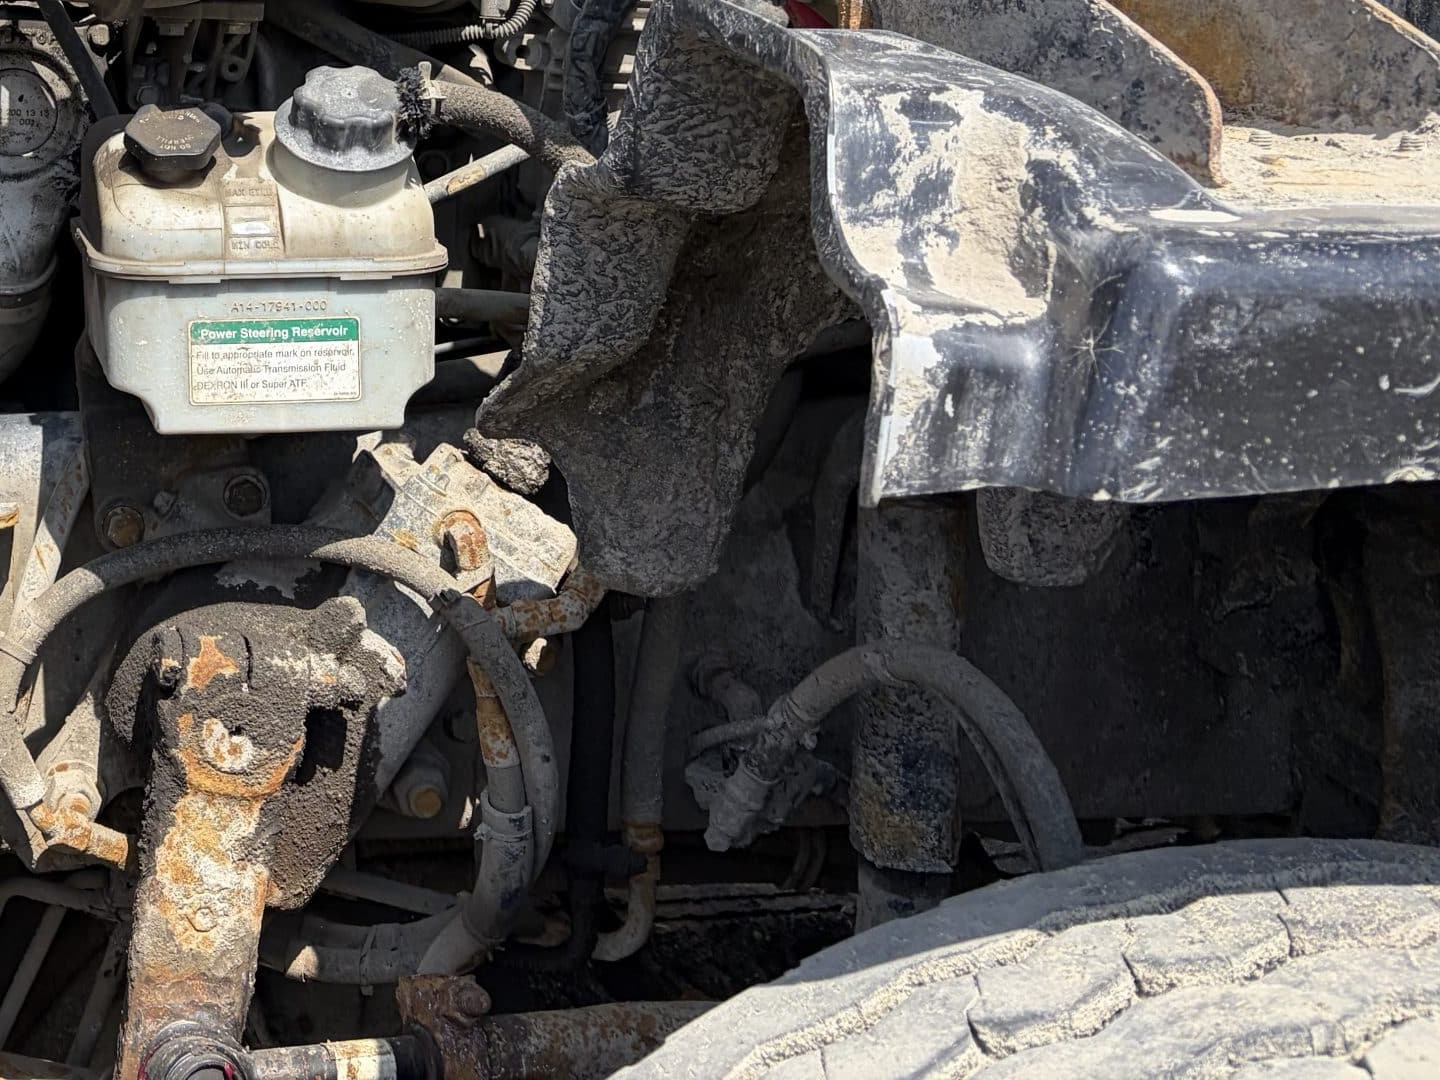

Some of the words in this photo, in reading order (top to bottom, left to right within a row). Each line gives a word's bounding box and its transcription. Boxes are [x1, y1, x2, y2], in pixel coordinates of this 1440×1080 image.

[200, 328, 238, 340] Power
[240, 327, 289, 341] Steering
[292, 324, 349, 339] Reservoir
[211, 351, 220, 360] to
[222, 350, 273, 361] appropriate
[275, 349, 298, 359] mark
[300, 350, 312, 358] on
[196, 365, 213, 375] Use
[216, 364, 262, 375] Automatic
[263, 362, 322, 374] Transmission
[324, 361, 347, 373] Fluid
[250, 381, 260, 389] or
[261, 379, 288, 390] Super
